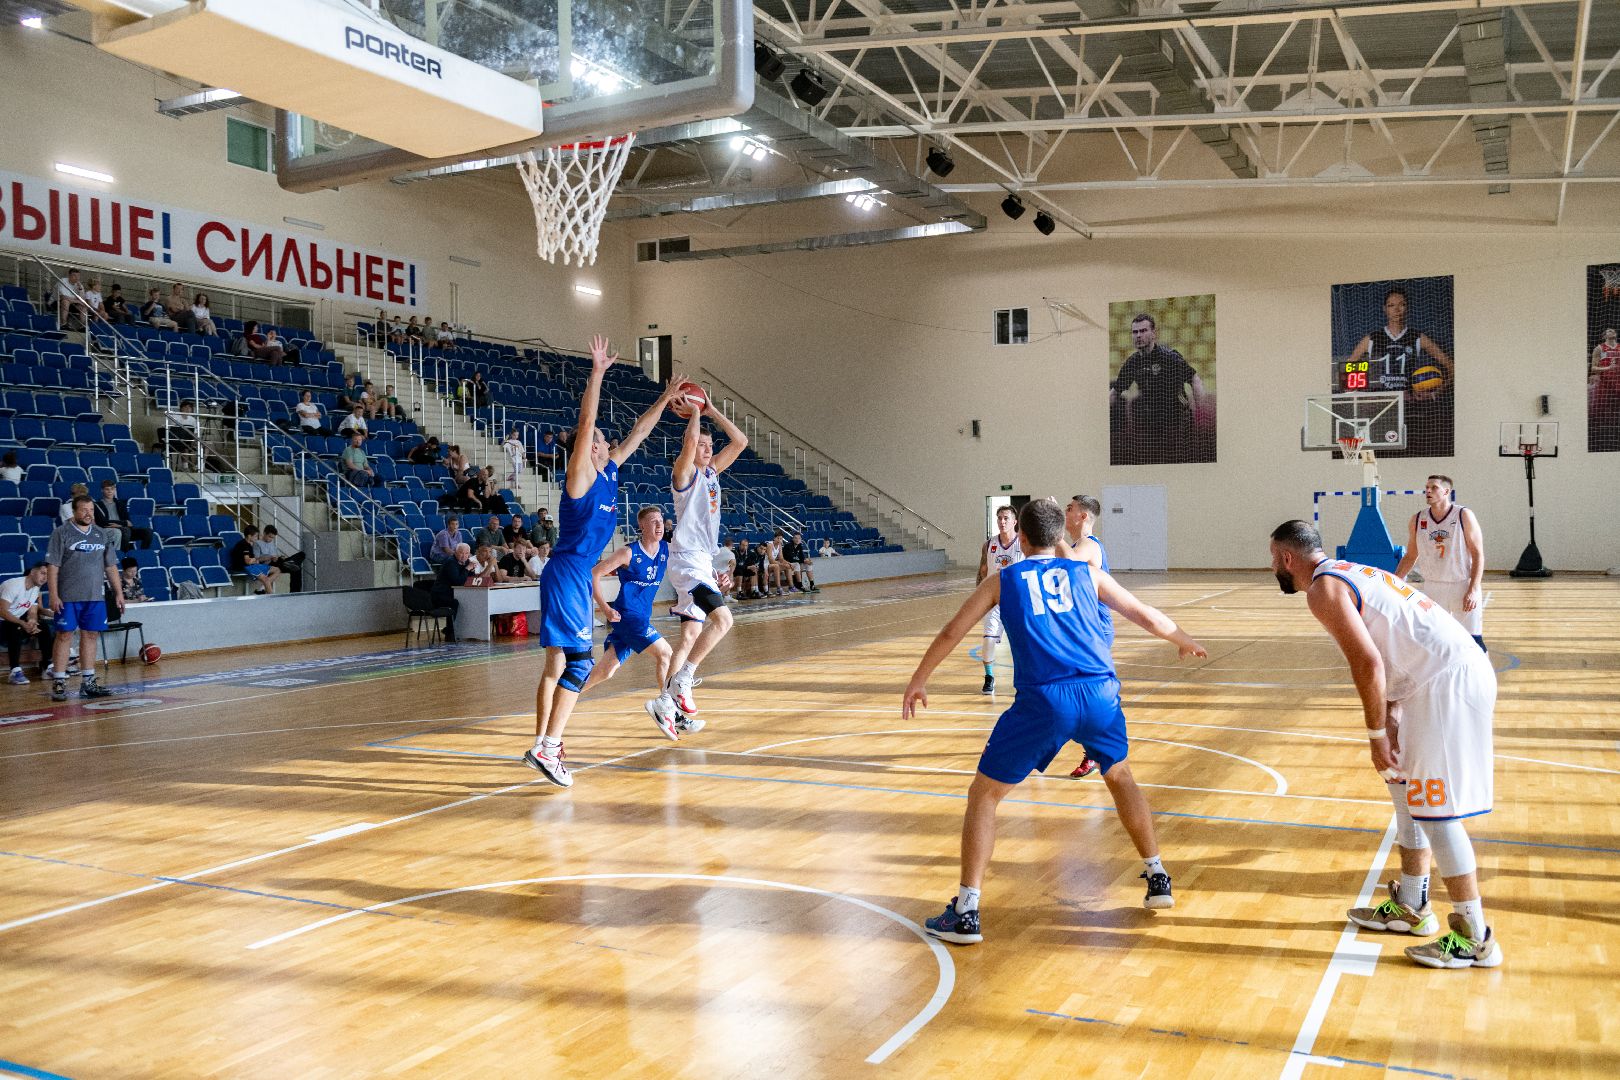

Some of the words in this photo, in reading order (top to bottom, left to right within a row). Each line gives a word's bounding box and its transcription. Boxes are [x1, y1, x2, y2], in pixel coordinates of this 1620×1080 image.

[0, 183, 171, 264] ЫШЕ!
[196, 221, 416, 306] СИЛЬНЕЕ!
[1345, 361, 1369, 373] 6:10
[1381, 353, 1406, 375] 11
[1347, 372, 1366, 388] 05
[1436, 544, 1445, 558] 7
[1021, 567, 1074, 616] 19
[1406, 778, 1447, 807] 28
